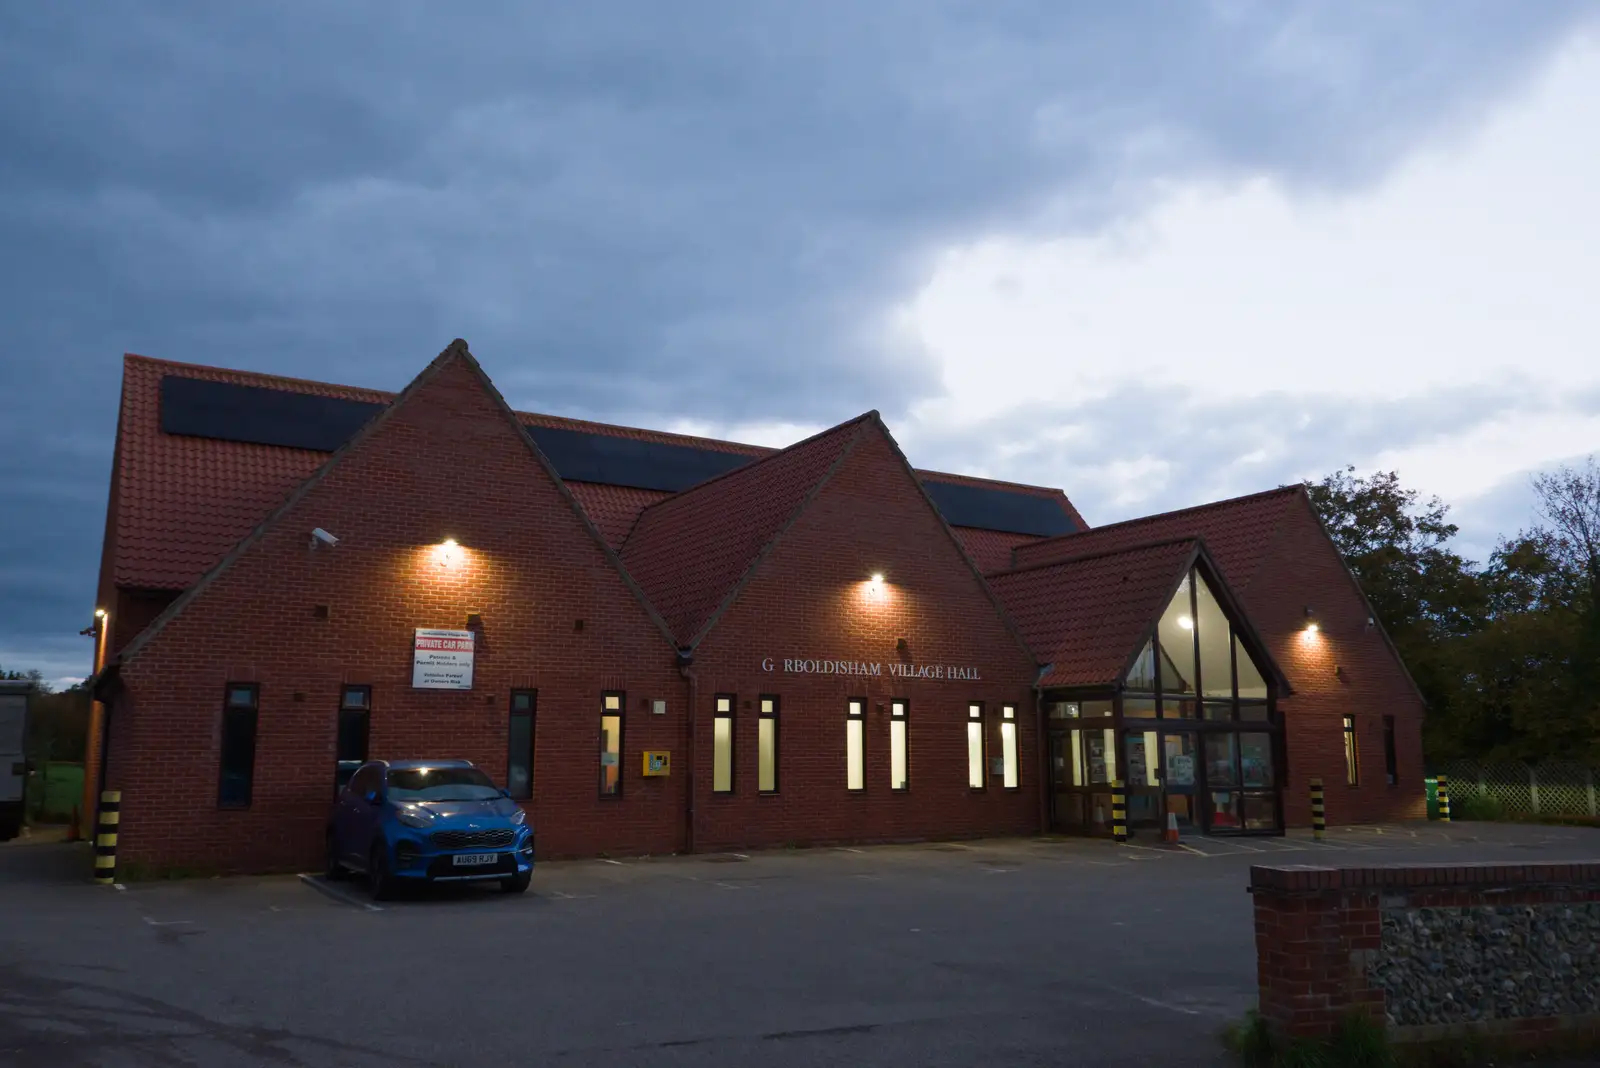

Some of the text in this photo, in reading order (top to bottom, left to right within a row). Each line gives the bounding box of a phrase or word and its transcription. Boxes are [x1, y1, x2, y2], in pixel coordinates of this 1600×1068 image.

[416, 639, 442, 649] PRIVATE
[443, 640, 456, 649] CAR
[888, 663, 944, 679] VILLAGE
[947, 666, 981, 680] HALL
[456, 855, 494, 864] AU69 RJY
